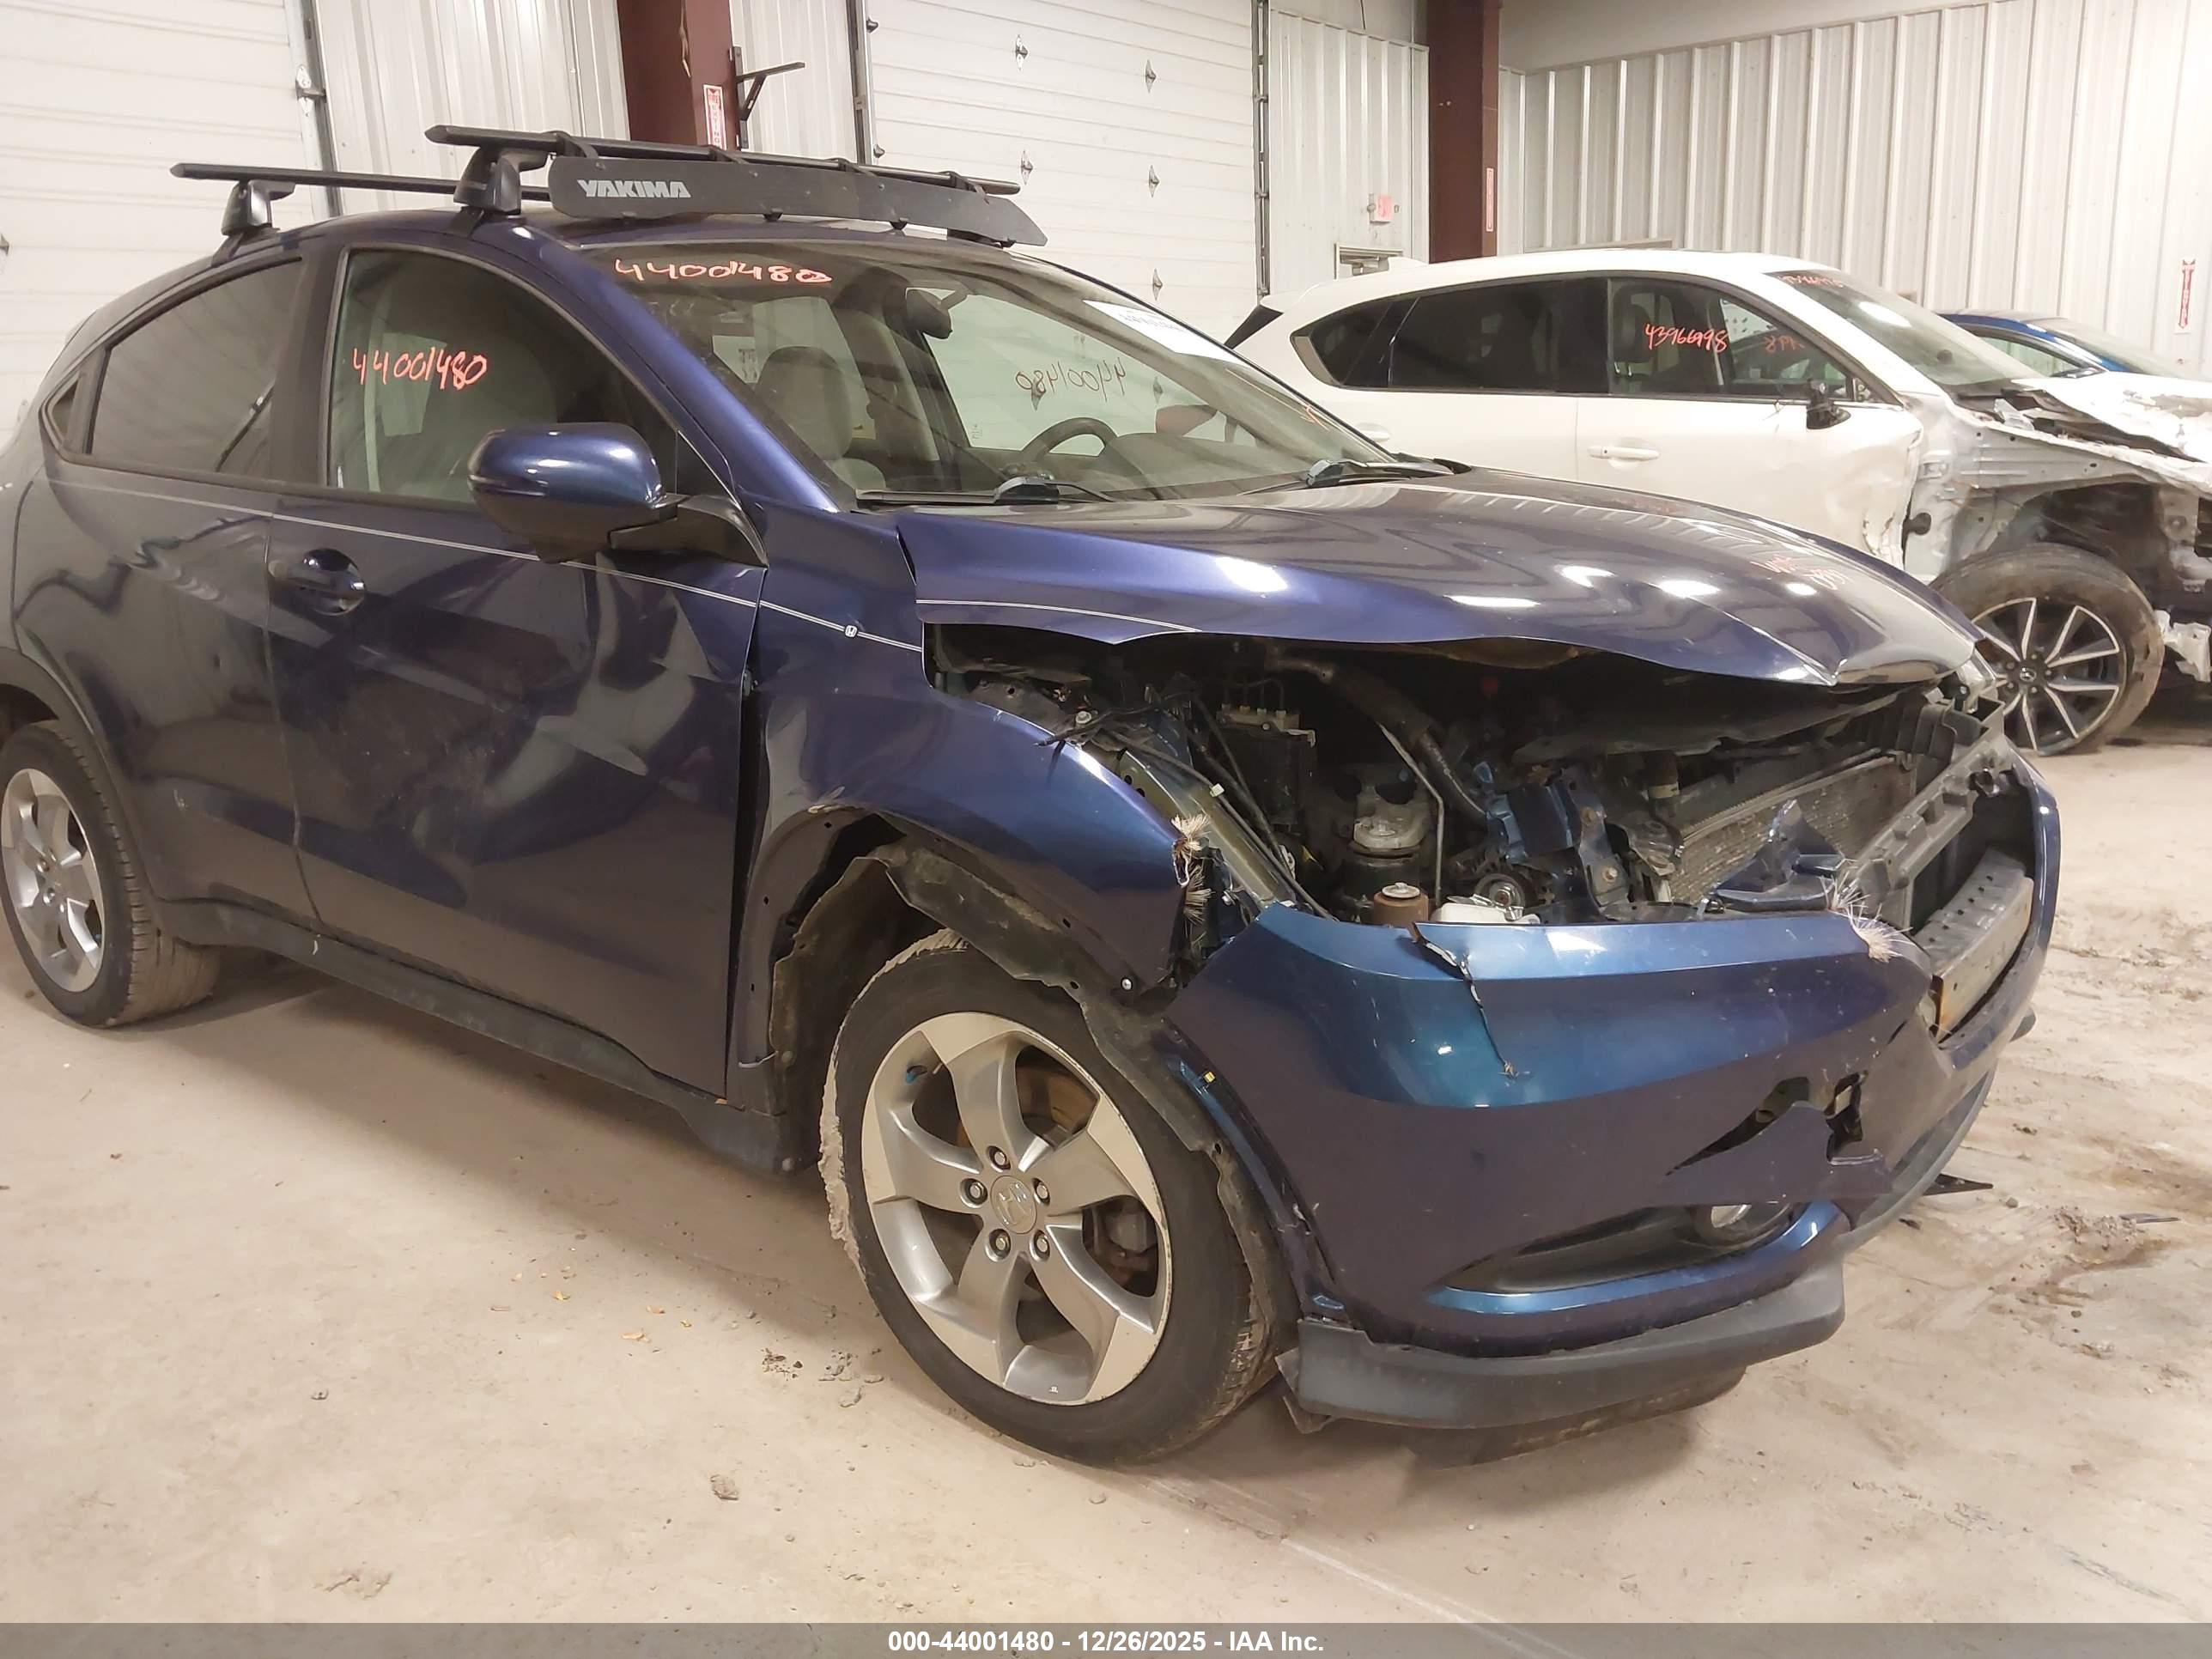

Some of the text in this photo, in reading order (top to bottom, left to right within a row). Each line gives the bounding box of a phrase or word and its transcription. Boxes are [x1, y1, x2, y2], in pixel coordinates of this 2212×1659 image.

[577, 179, 692, 198] YAKIMA
[614, 258, 833, 283] 44001480
[352, 346, 489, 391] 44001480
